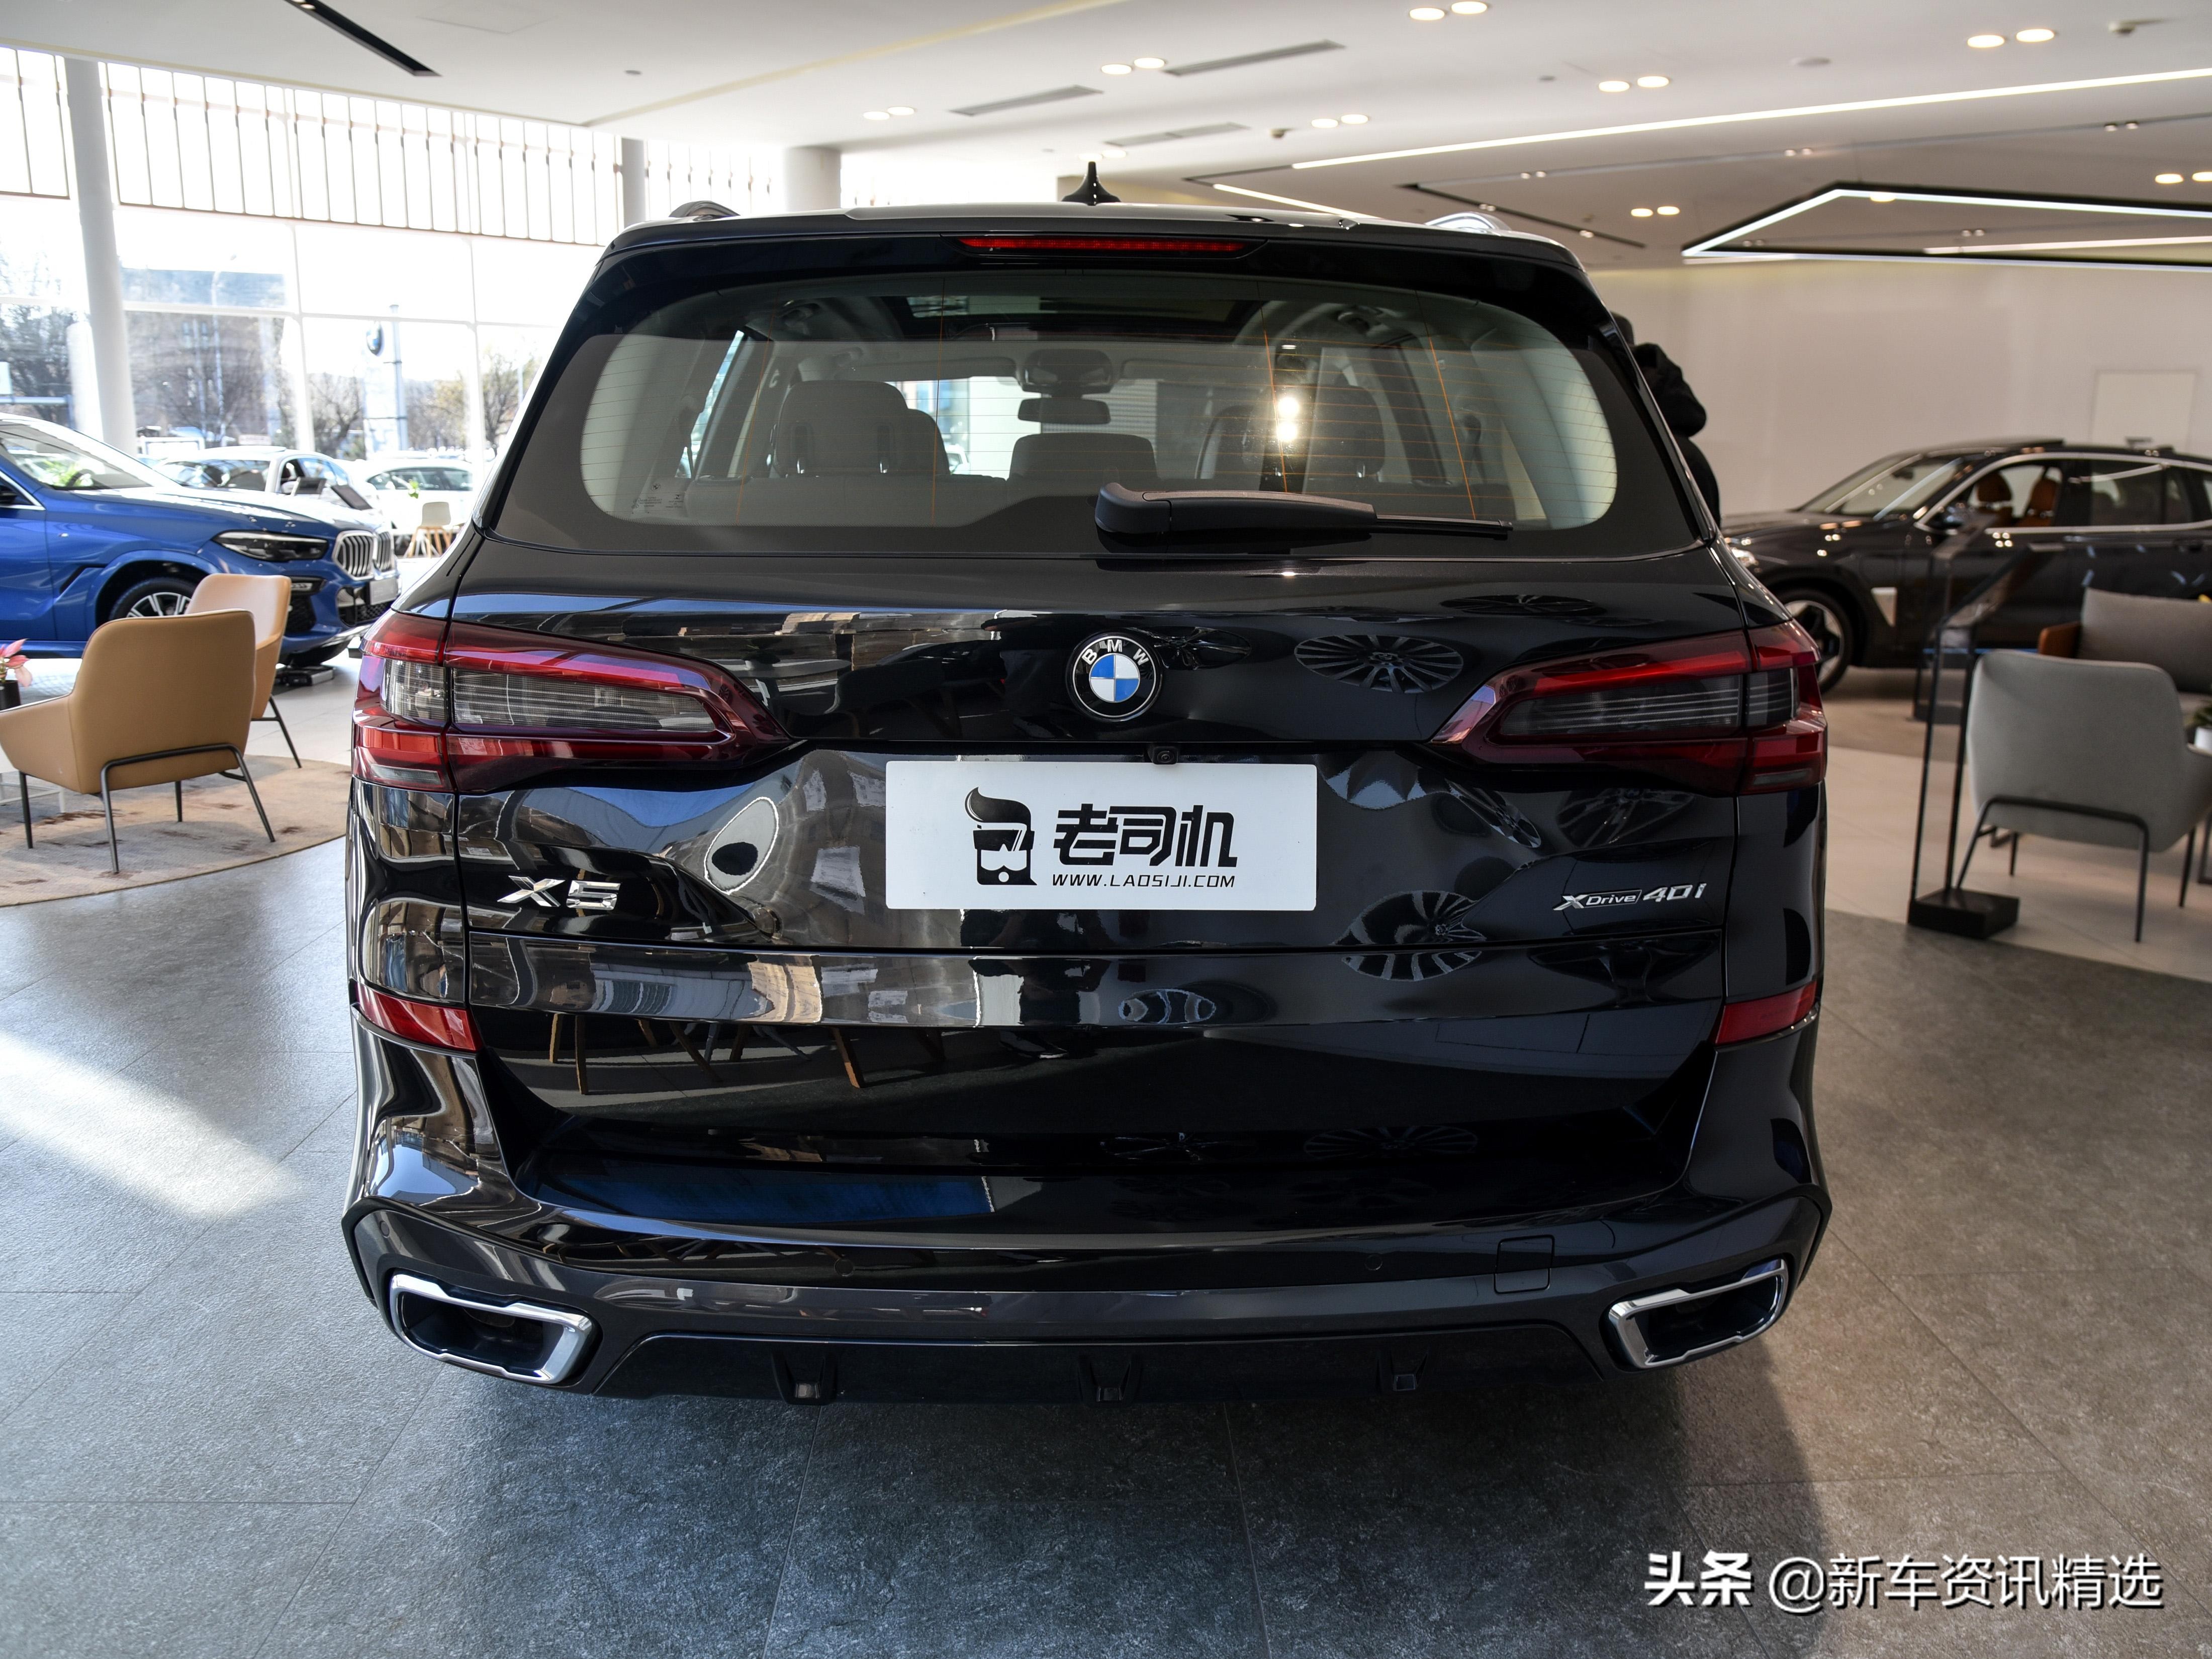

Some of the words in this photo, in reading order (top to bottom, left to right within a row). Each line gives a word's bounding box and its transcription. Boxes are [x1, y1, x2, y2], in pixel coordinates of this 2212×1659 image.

[1081, 639, 1149, 666] BMW
[1053, 803, 1238, 867] 老司机
[497, 875, 621, 911] X5
[1052, 874, 1235, 888] WWW.LAOSIJI.COM
